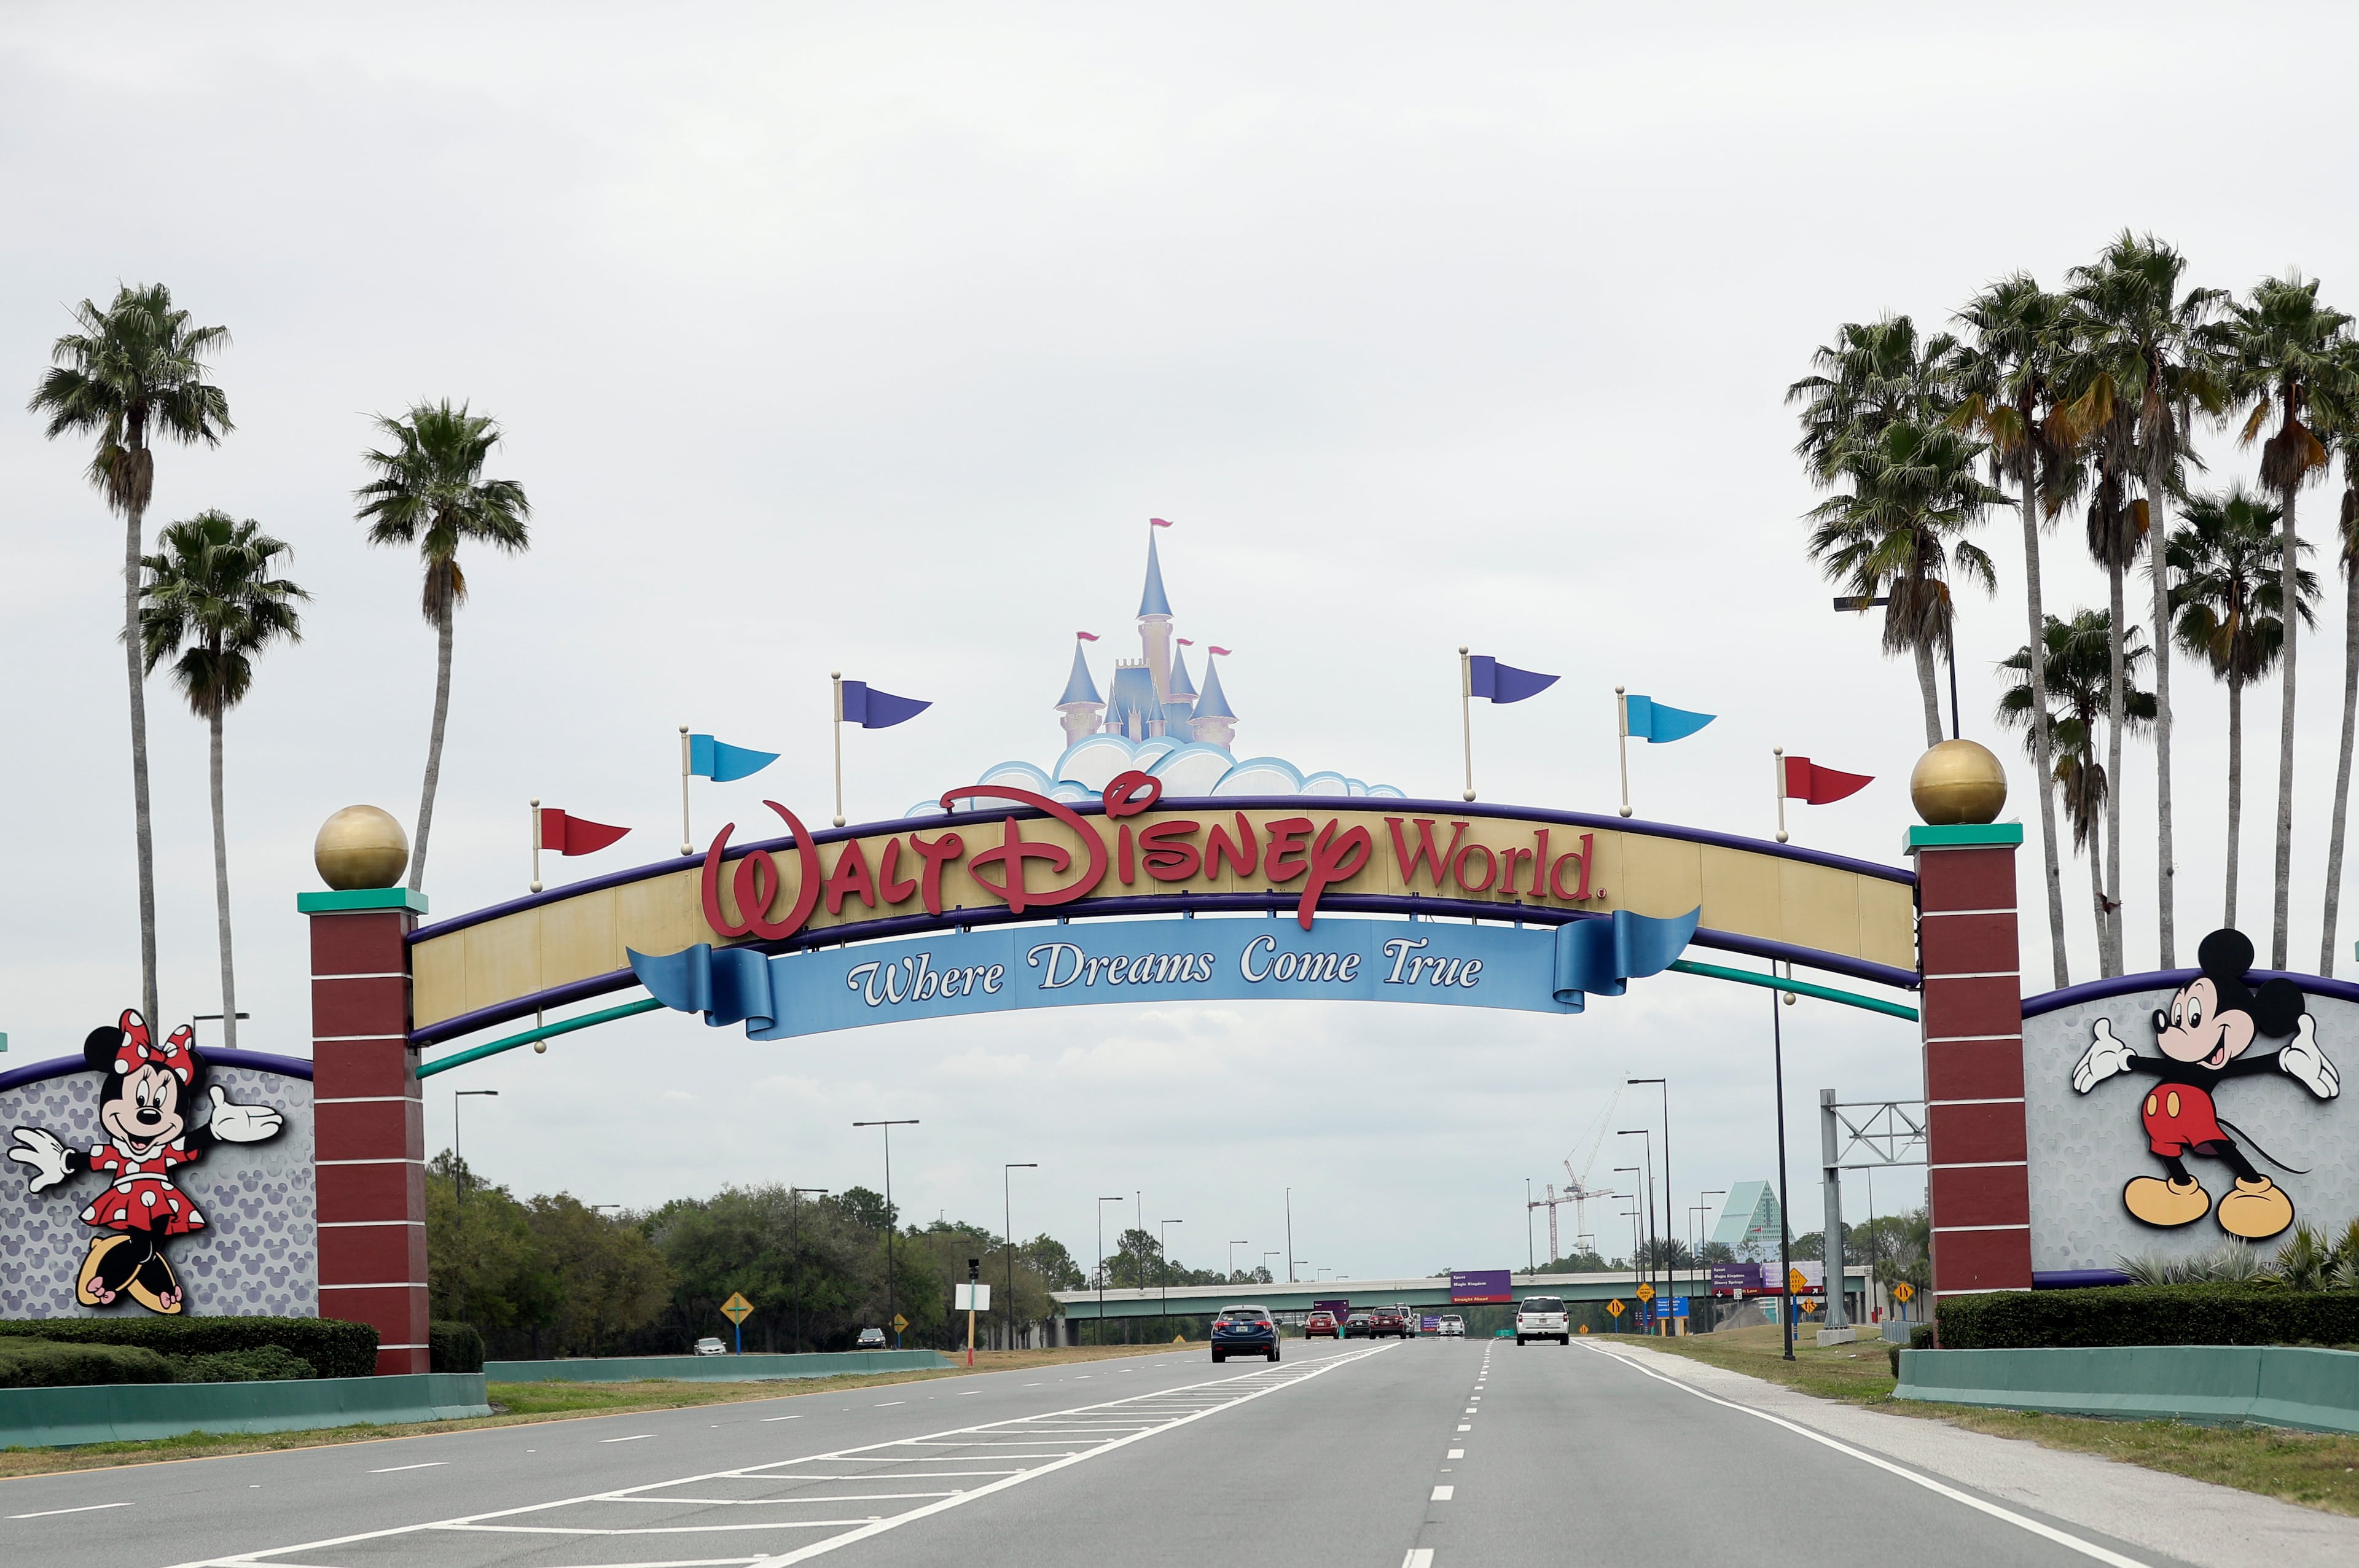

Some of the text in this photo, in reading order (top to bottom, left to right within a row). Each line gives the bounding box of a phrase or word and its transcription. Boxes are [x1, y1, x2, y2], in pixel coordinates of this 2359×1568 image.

[847, 934, 1484, 1008] Where Dreams Come True
